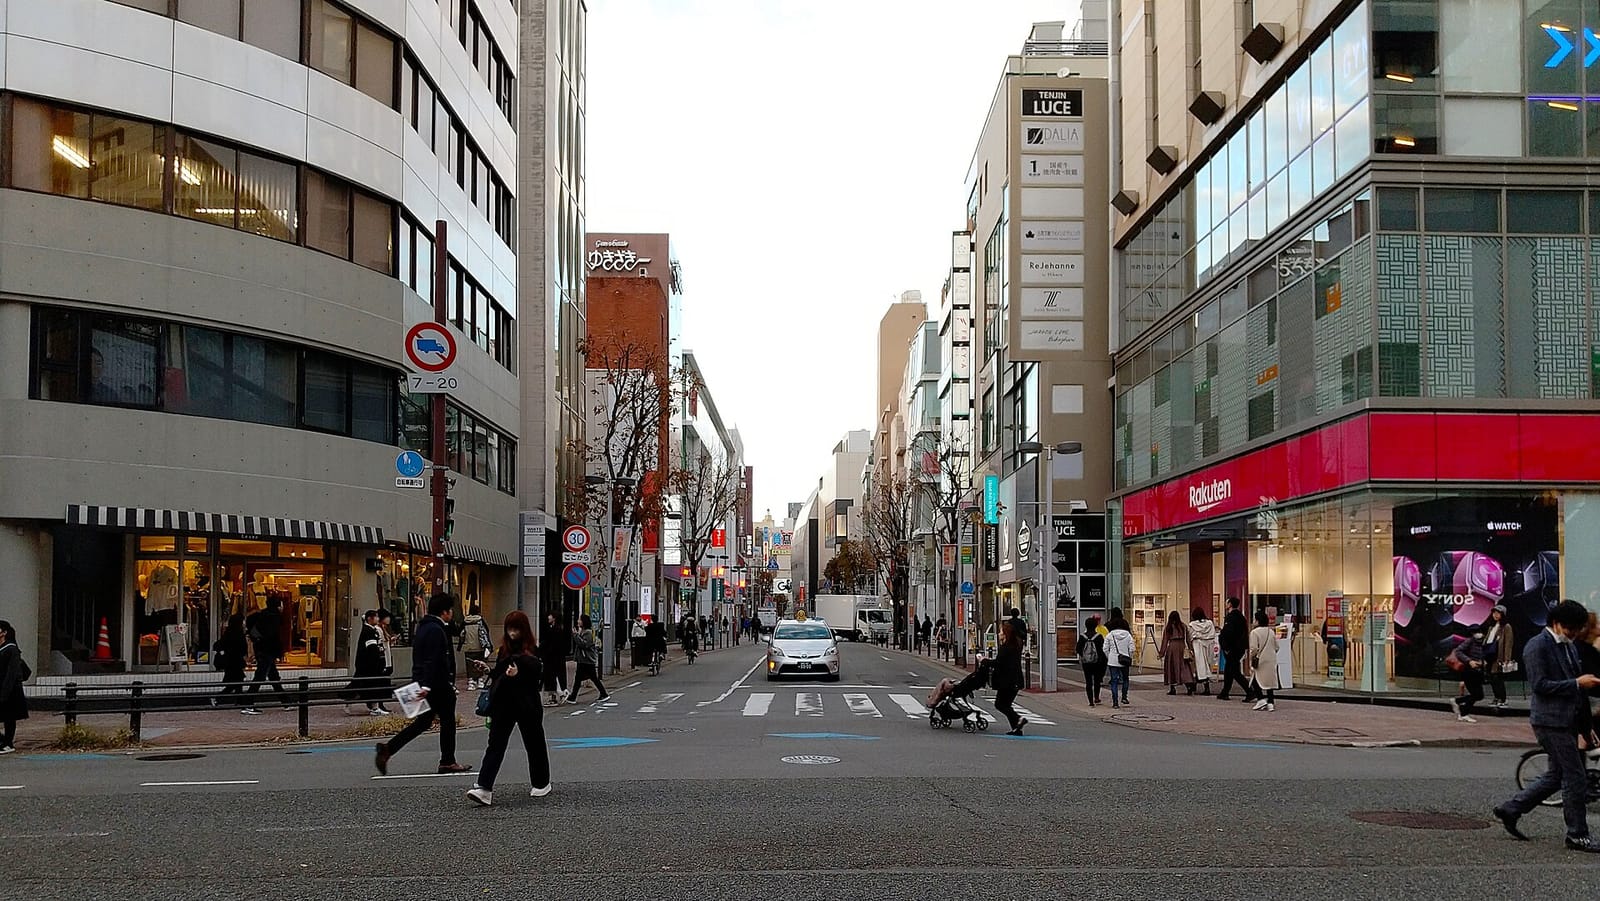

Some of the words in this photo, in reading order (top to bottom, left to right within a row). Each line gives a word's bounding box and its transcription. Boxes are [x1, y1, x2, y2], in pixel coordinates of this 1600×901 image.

[1039, 91, 1067, 99] TENJIN
[1033, 101, 1072, 114] LUCE
[1030, 160, 1037, 173] 1
[587, 249, 641, 271] ゆきざき
[1029, 262, 1075, 270] ReJehanne
[1189, 479, 1231, 508] Rakuten
[1056, 526, 1076, 535] UCE
[1494, 522, 1521, 530] WATCH
[569, 533, 585, 545] 30
[564, 553, 589, 561] ここから
